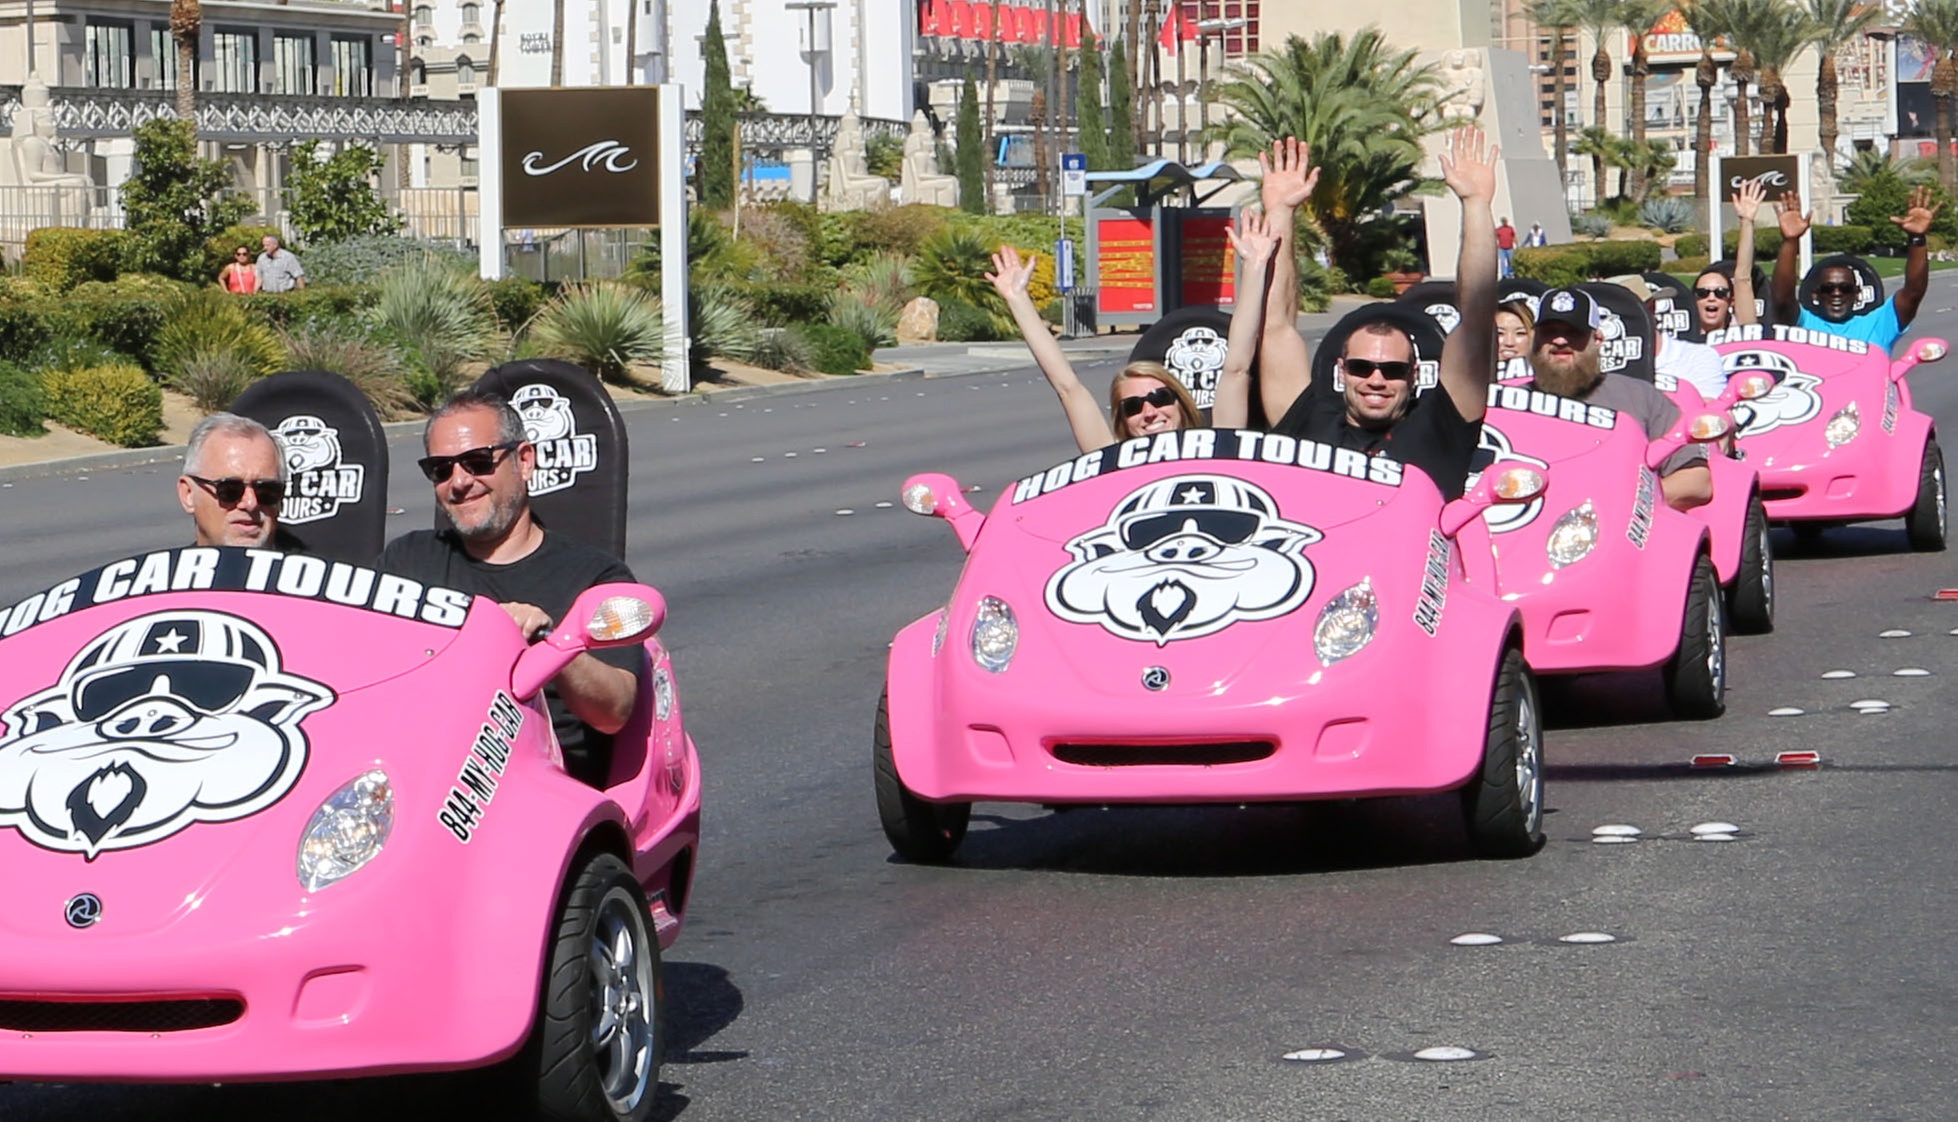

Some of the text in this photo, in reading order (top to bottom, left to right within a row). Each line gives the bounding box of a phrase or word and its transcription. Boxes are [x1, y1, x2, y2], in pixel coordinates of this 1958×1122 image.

[1600, 340, 1637, 357] CAR
[1706, 324, 1868, 354] CAR TOURS
[537, 439, 592, 468] CAR
[1012, 429, 1403, 505] HOG CAR TOURS
[300, 470, 357, 497] CAR
[93, 548, 220, 603] CAR
[245, 549, 472, 627] TOURS
[439, 691, 523, 843] 844-MY-HOG-CAR
